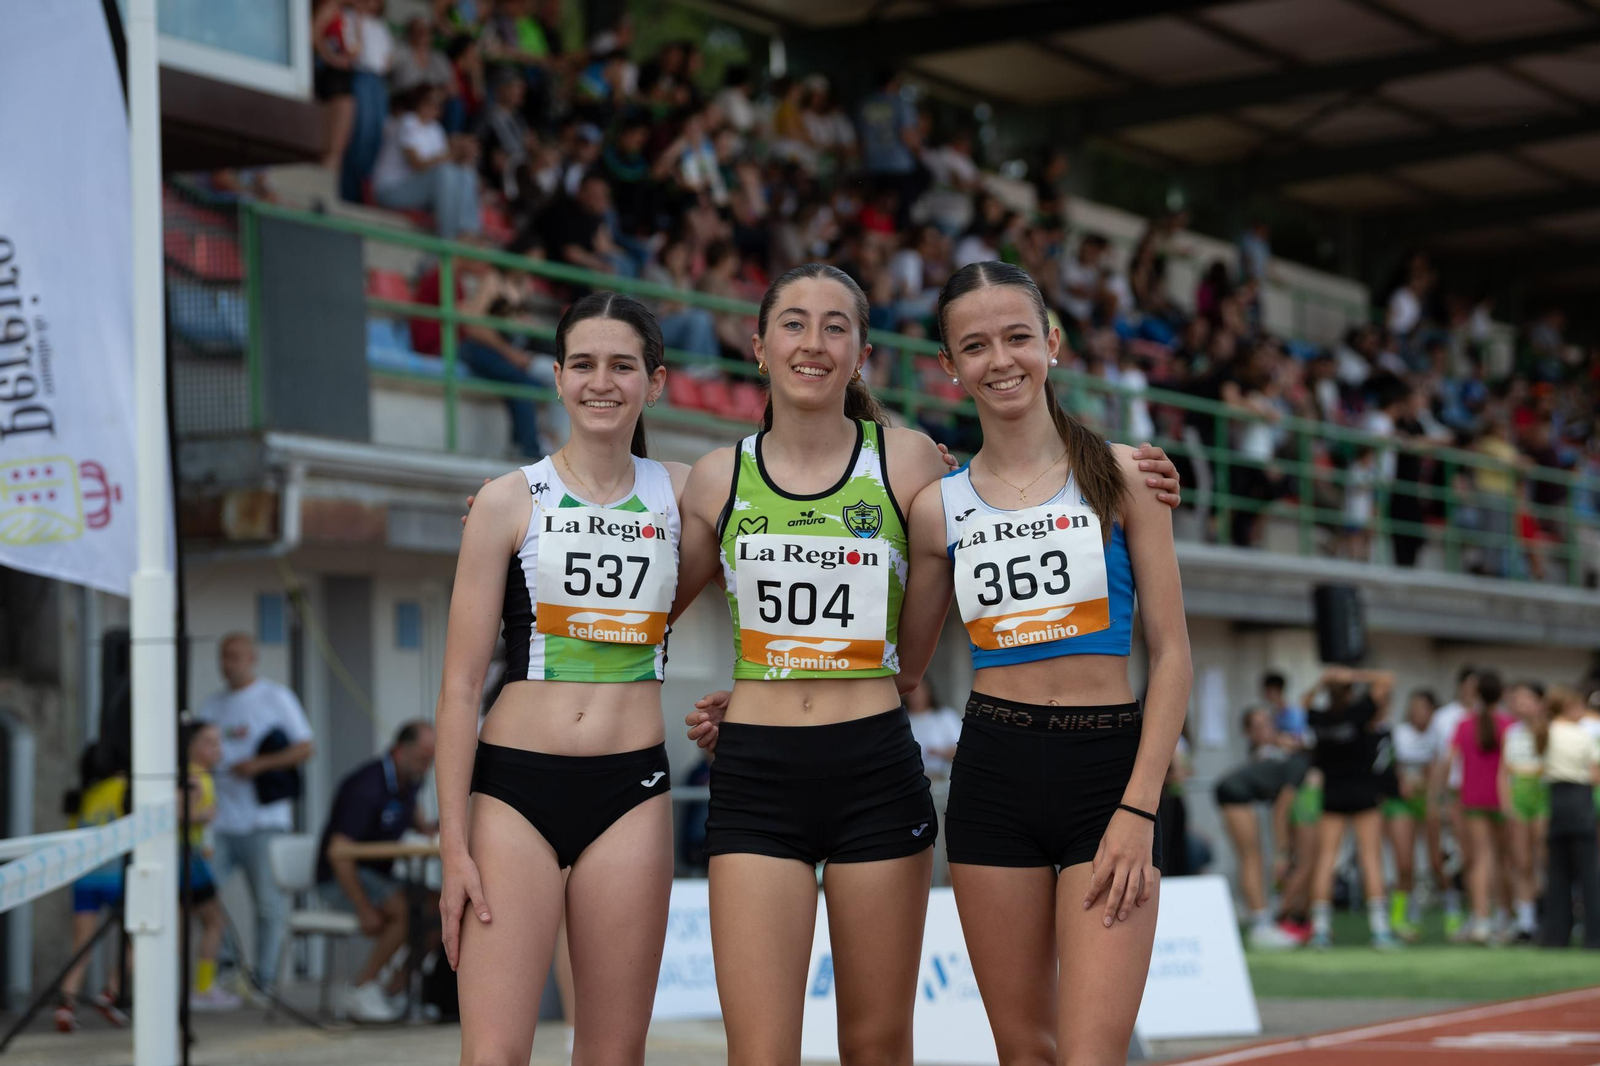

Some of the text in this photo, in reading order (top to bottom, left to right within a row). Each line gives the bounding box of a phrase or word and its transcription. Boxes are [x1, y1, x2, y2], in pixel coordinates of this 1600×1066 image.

[543, 515, 667, 542] La Región
[787, 517, 826, 527] amura
[957, 513, 1090, 550] La Región
[739, 542, 879, 570] La Región
[564, 551, 650, 599] 537
[973, 550, 1070, 606] 363
[757, 580, 854, 627] 504
[568, 623, 648, 643] telemiño
[996, 623, 1078, 648] telemiño
[766, 652, 849, 669] telemiño
[1048, 714, 1112, 730] NIKE
